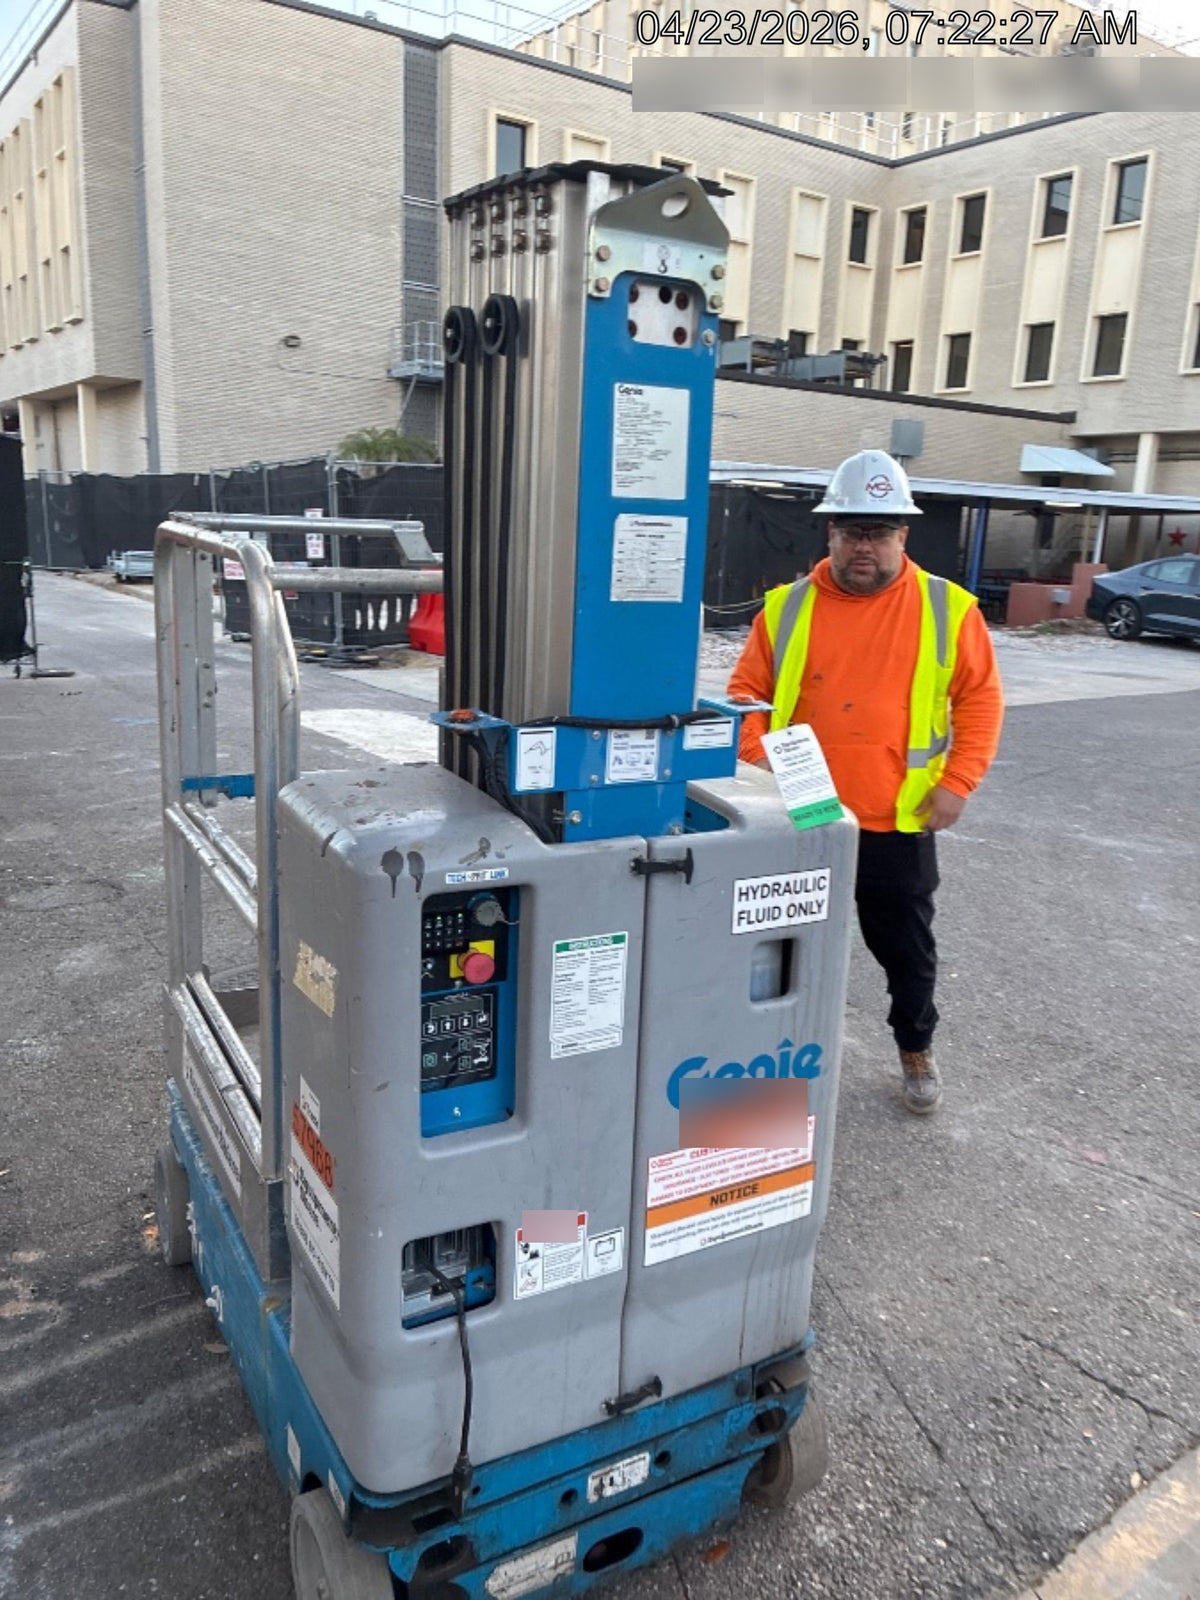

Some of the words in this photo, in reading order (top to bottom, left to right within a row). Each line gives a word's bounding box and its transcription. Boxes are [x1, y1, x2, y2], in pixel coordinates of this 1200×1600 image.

[738, 875, 827, 902] HYDRAULIC
[737, 906, 781, 927] FLUID
[786, 899, 825, 919] ONLY
[710, 1183, 760, 1207] NOTICE
